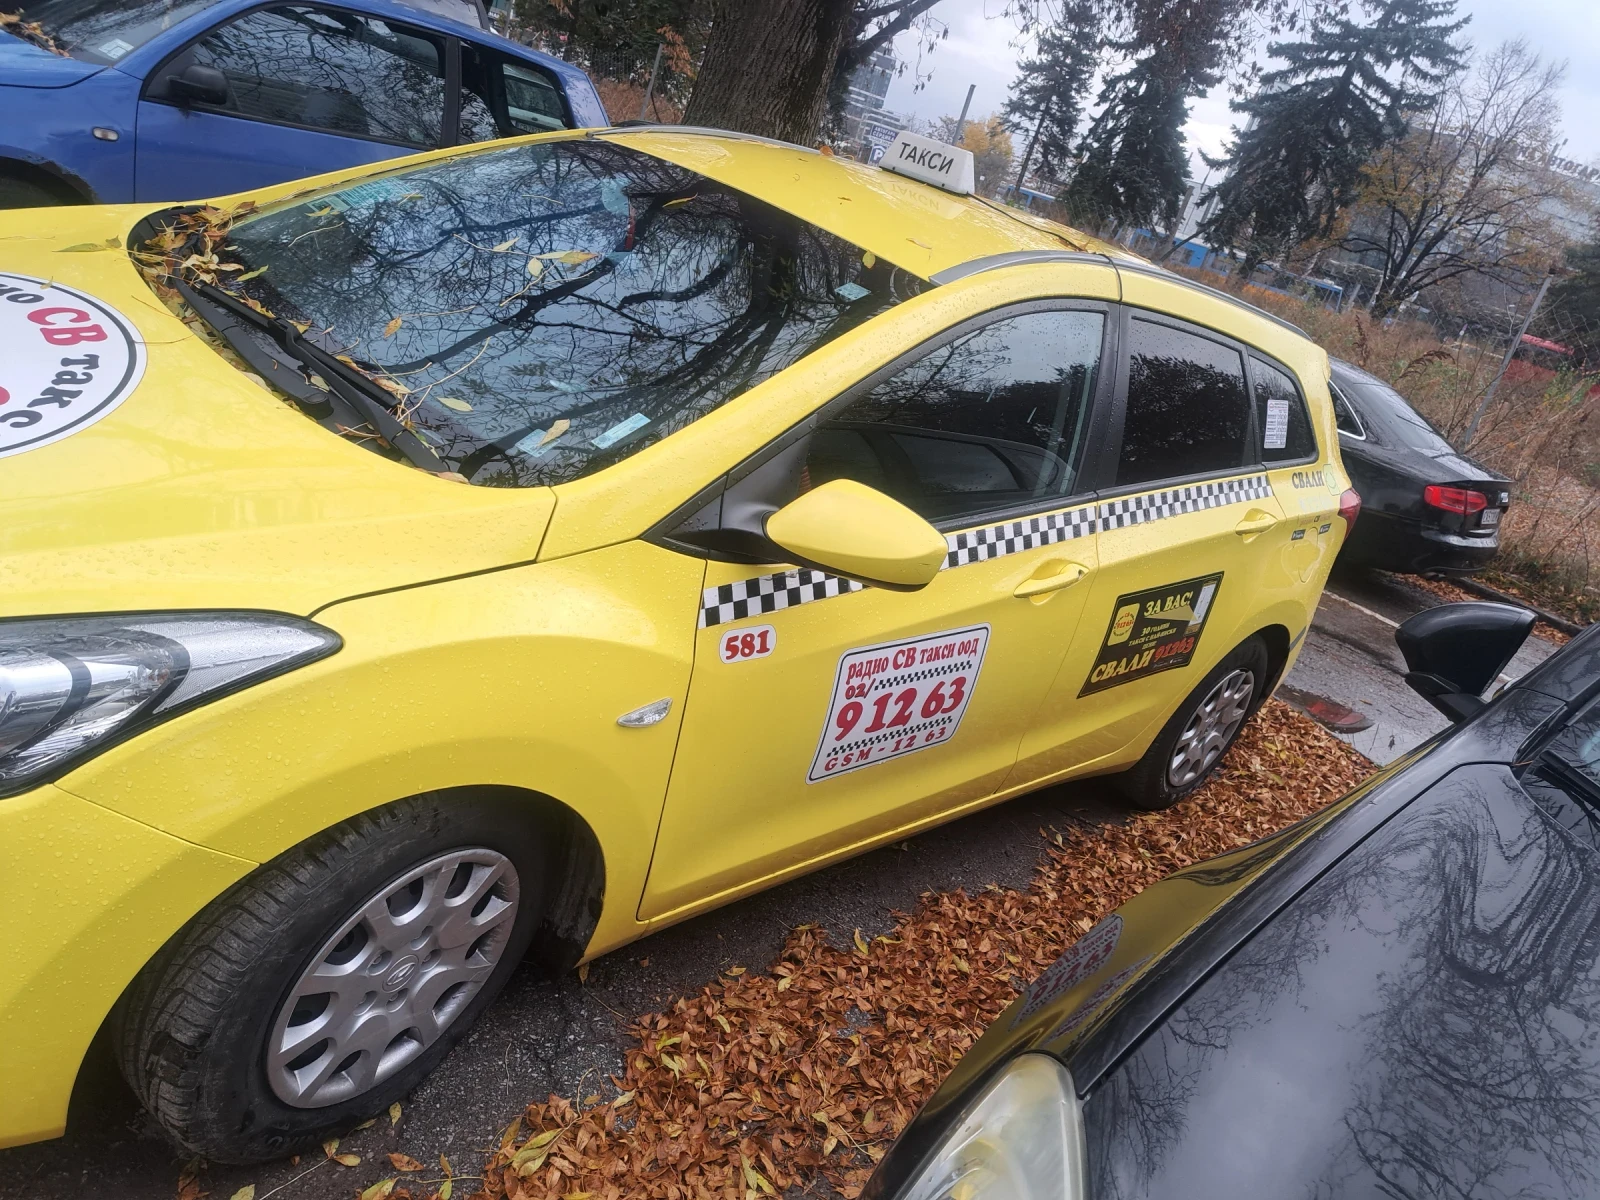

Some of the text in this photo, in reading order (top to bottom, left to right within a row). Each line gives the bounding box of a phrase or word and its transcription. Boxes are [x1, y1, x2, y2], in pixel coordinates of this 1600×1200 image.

[899, 142, 954, 175] ТАКСИ
[1547, 155, 1600, 181] ВТОГАР
[27, 307, 108, 346] СВ
[0, 353, 100, 429] такс
[1291, 471, 1325, 489] СВАЛИ
[1143, 599, 1161, 617] ЗА
[725, 629, 770, 660] 581
[845, 637, 980, 685] радио СВ такси оод
[1090, 648, 1156, 683] СВАЛИ
[844, 678, 876, 700] 02/
